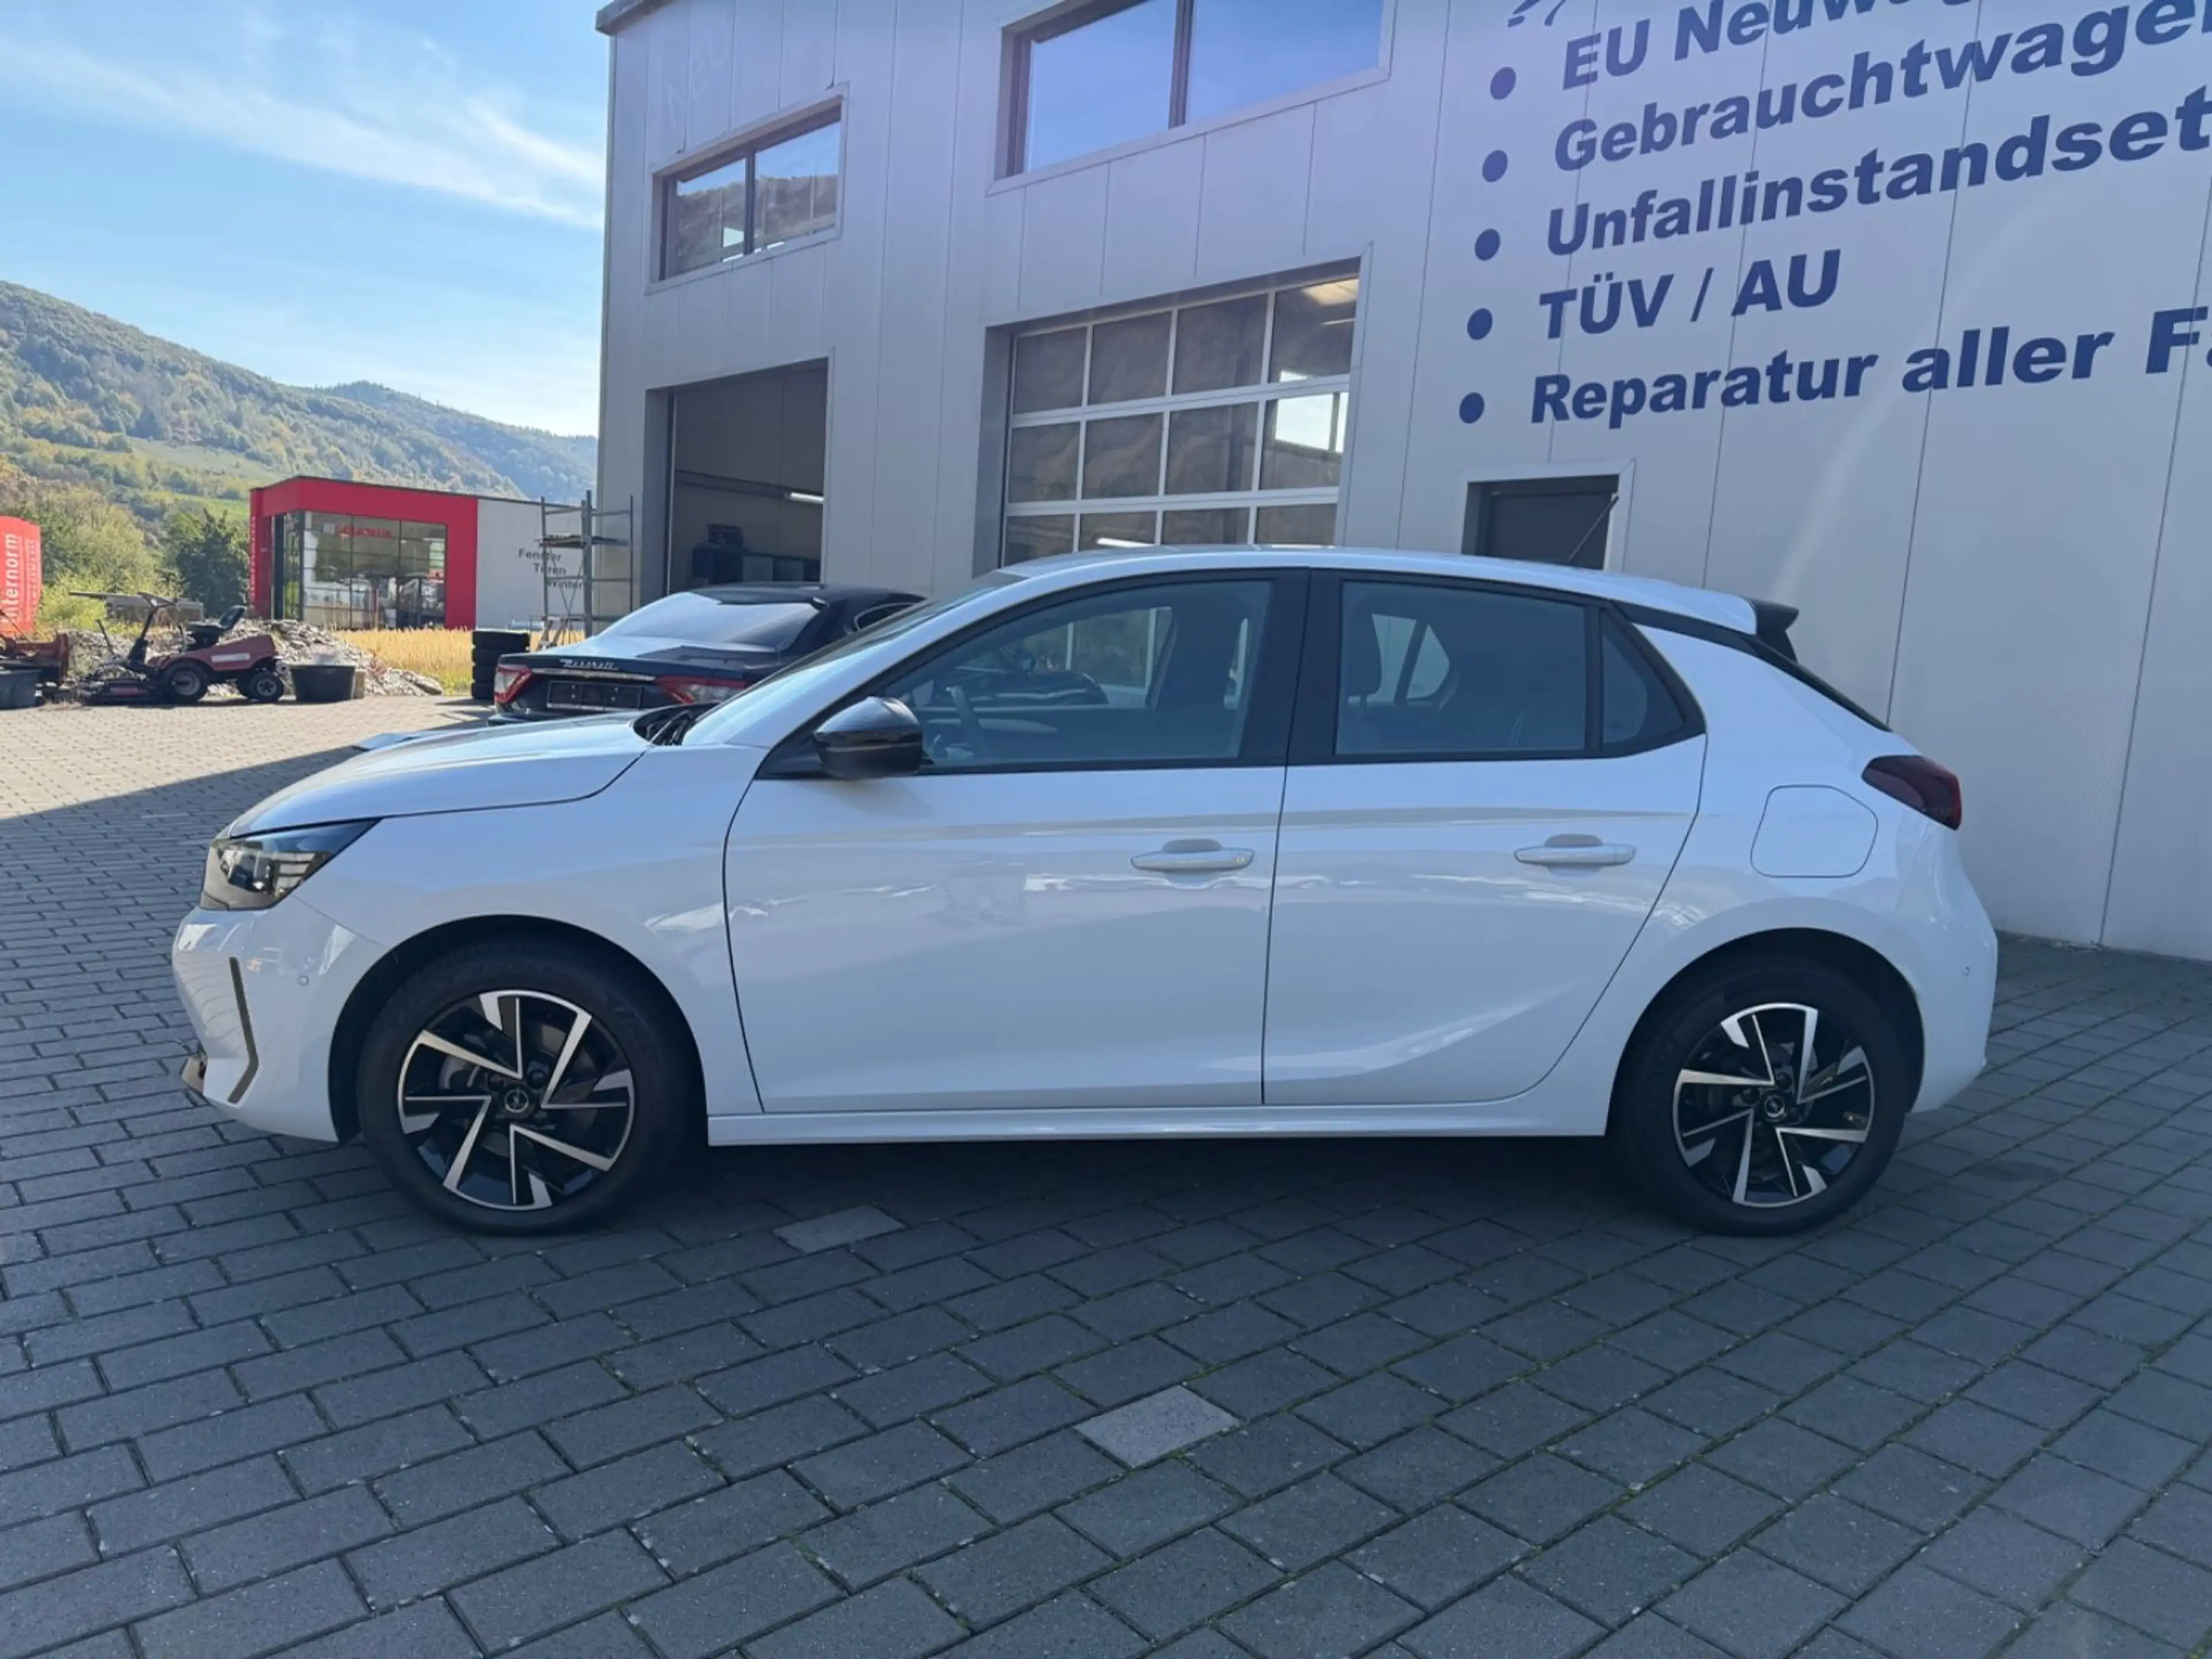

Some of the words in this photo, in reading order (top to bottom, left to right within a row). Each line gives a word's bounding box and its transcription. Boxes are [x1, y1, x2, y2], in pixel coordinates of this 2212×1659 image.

[1555, 0, 2212, 172] Gebrauchtwage
[1563, 18, 1650, 90] EU
[1674, 0, 1970, 60] Neu
[1547, 86, 2212, 257] Unfallinstandset
[1539, 273, 1673, 340] TÜV
[1691, 268, 1713, 322] /
[1731, 248, 1841, 317] AU
[1531, 351, 1878, 430] Reparatur
[1902, 325, 2115, 394] aller
[2145, 306, 2212, 374] F
